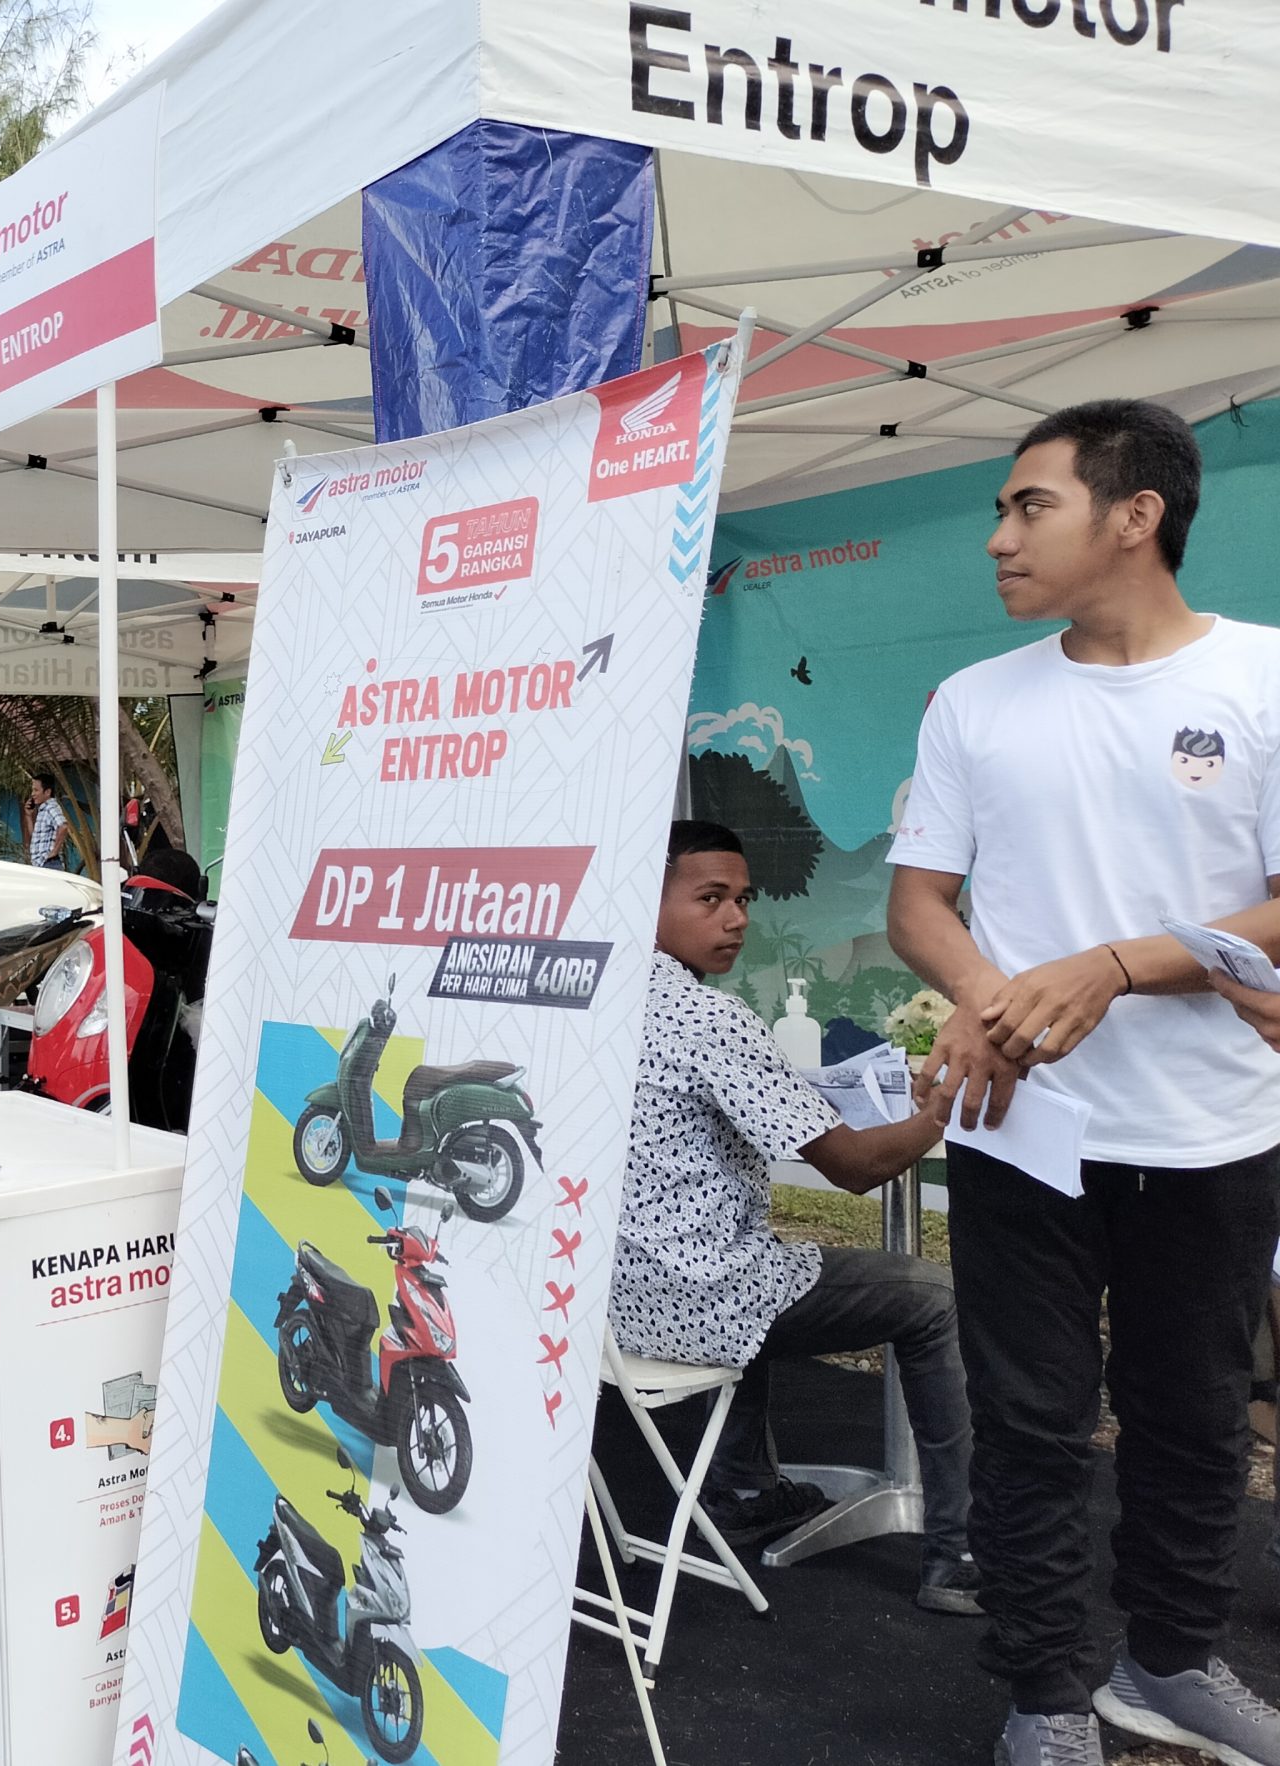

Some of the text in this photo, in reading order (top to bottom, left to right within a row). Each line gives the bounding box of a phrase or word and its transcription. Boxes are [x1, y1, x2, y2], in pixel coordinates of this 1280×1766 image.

[628, 5, 970, 187] Entrop
[25, 256, 36, 270] of
[36, 238, 66, 265] ASTRA
[1, 311, 63, 364] ENTROP
[615, 421, 677, 446] HONDA
[596, 439, 690, 480] One HEART.
[328, 459, 428, 498] astra motor
[396, 481, 421, 494] ASTRA
[295, 525, 347, 544] JAYAPURA
[466, 508, 532, 540] TAHUN
[425, 522, 460, 585] 5
[463, 534, 529, 559] GARANSI
[744, 538, 882, 579] astra motor
[461, 553, 523, 578] RANGKA
[421, 598, 446, 609] Semua
[446, 594, 468, 605] Motor
[468, 590, 493, 602] Honda
[337, 660, 576, 728] ASTRA MOTOR
[380, 729, 508, 782] ENTROP
[316, 864, 561, 936] DP 1 Jutaan
[444, 941, 535, 978] ANGSURAN
[439, 974, 528, 998] PER HARI CUMA
[32, 1245, 120, 1279] KENAPA
[50, 1274, 122, 1309] astra
[55, 1424, 71, 1442] 4.
[98, 1473, 127, 1489] Astra
[100, 1496, 129, 1513] Proses
[100, 1512, 126, 1528] Aman
[129, 1510, 135, 1519] &
[60, 1602, 77, 1621] 5.
